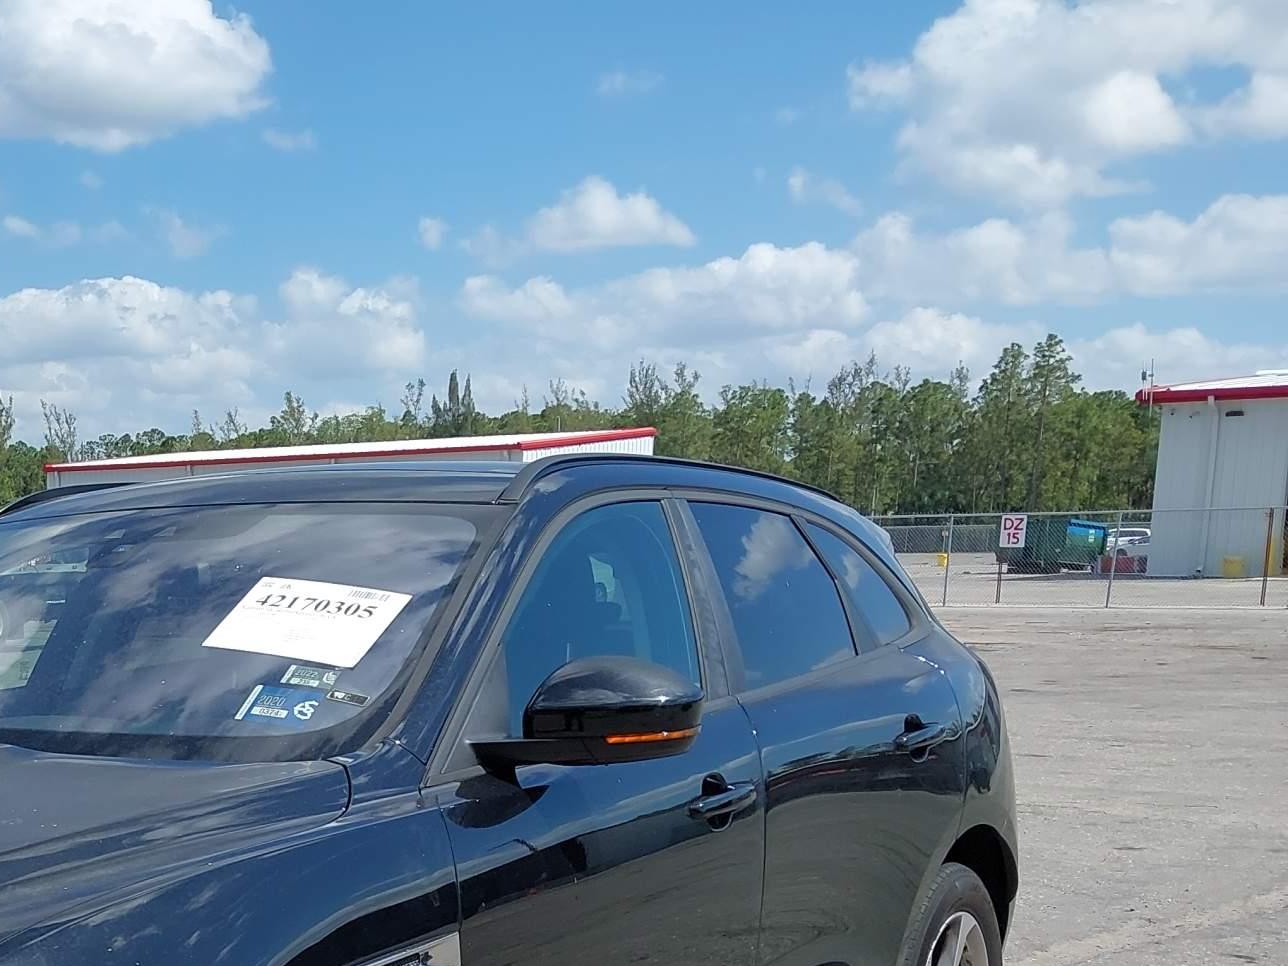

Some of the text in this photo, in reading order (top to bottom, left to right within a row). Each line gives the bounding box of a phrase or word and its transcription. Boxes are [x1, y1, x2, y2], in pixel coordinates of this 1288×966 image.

[1003, 517, 1025, 531] DZ
[1006, 532, 1020, 545] 15
[255, 593, 379, 620] 42170305
[257, 695, 287, 706] 2020
